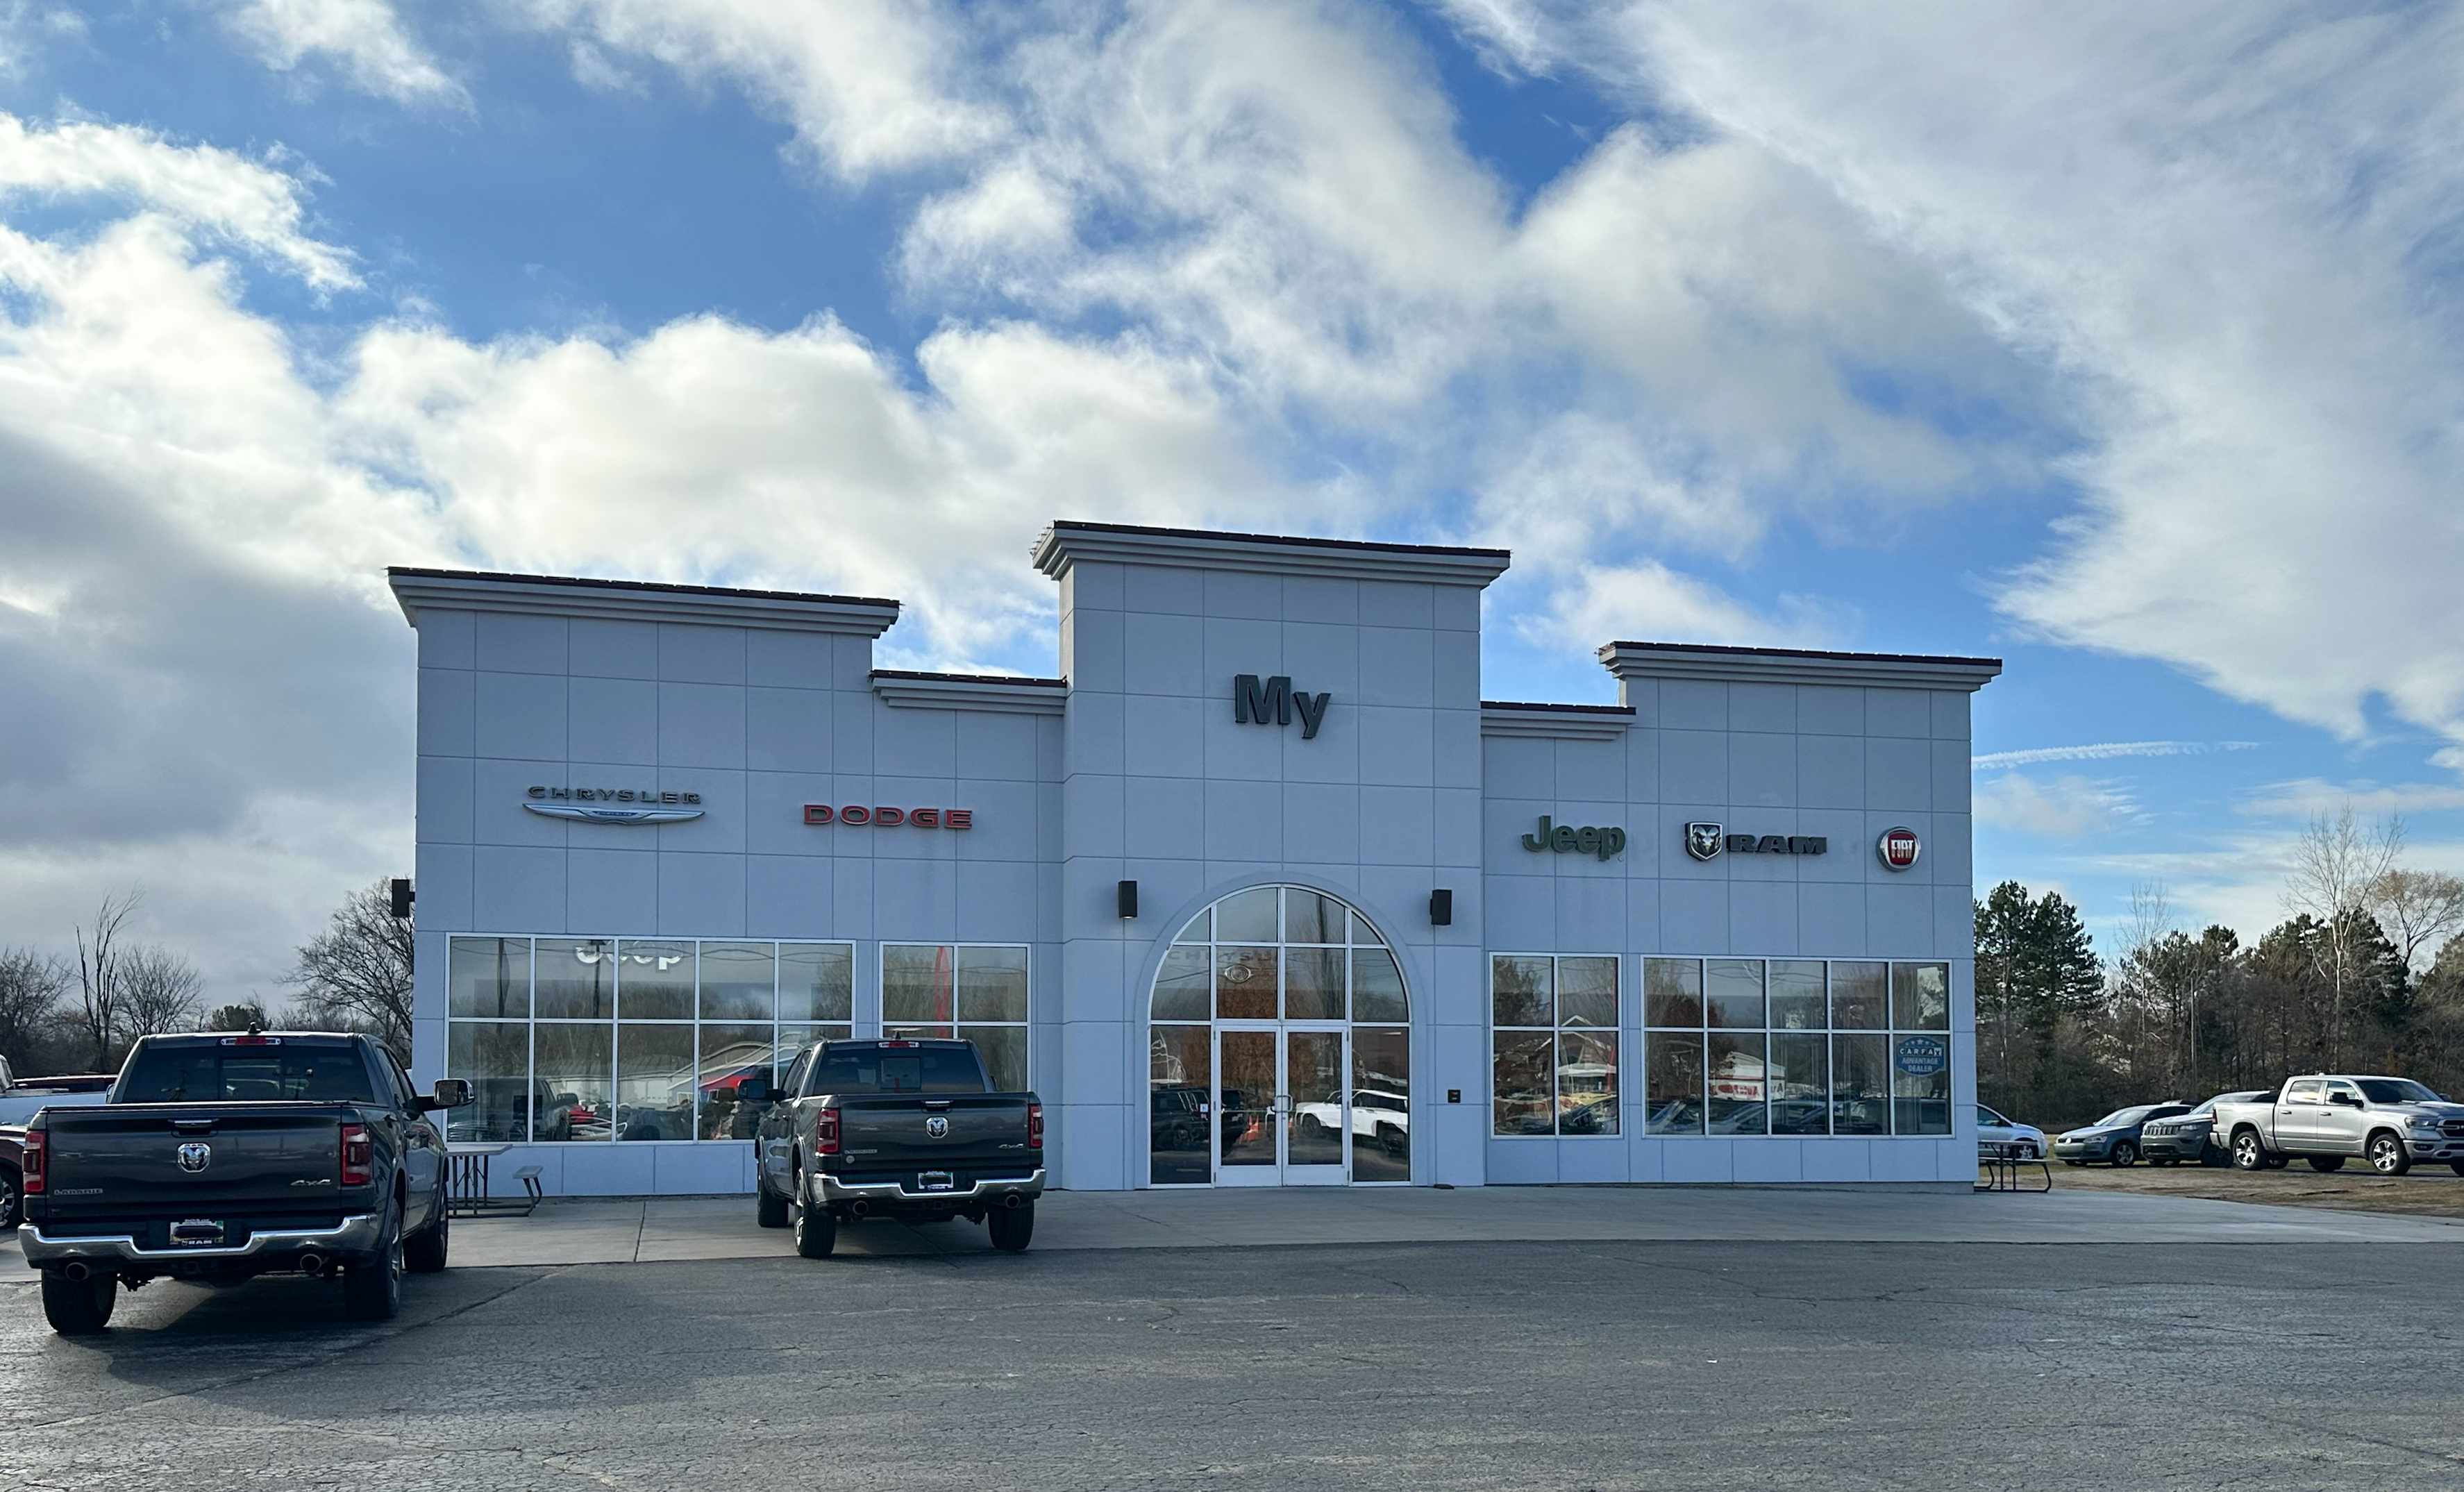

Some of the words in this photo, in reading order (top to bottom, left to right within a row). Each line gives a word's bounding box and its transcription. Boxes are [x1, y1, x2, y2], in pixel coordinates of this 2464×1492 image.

[1234, 674, 1332, 739] My
[528, 786, 701, 804] CHRYSLER
[803, 804, 972, 829] DODGE
[1522, 815, 1626, 862] Jeep
[1726, 834, 1827, 855] RAM
[1891, 839, 1914, 859] FIAT
[1900, 1048, 1942, 1056] CARFAX
